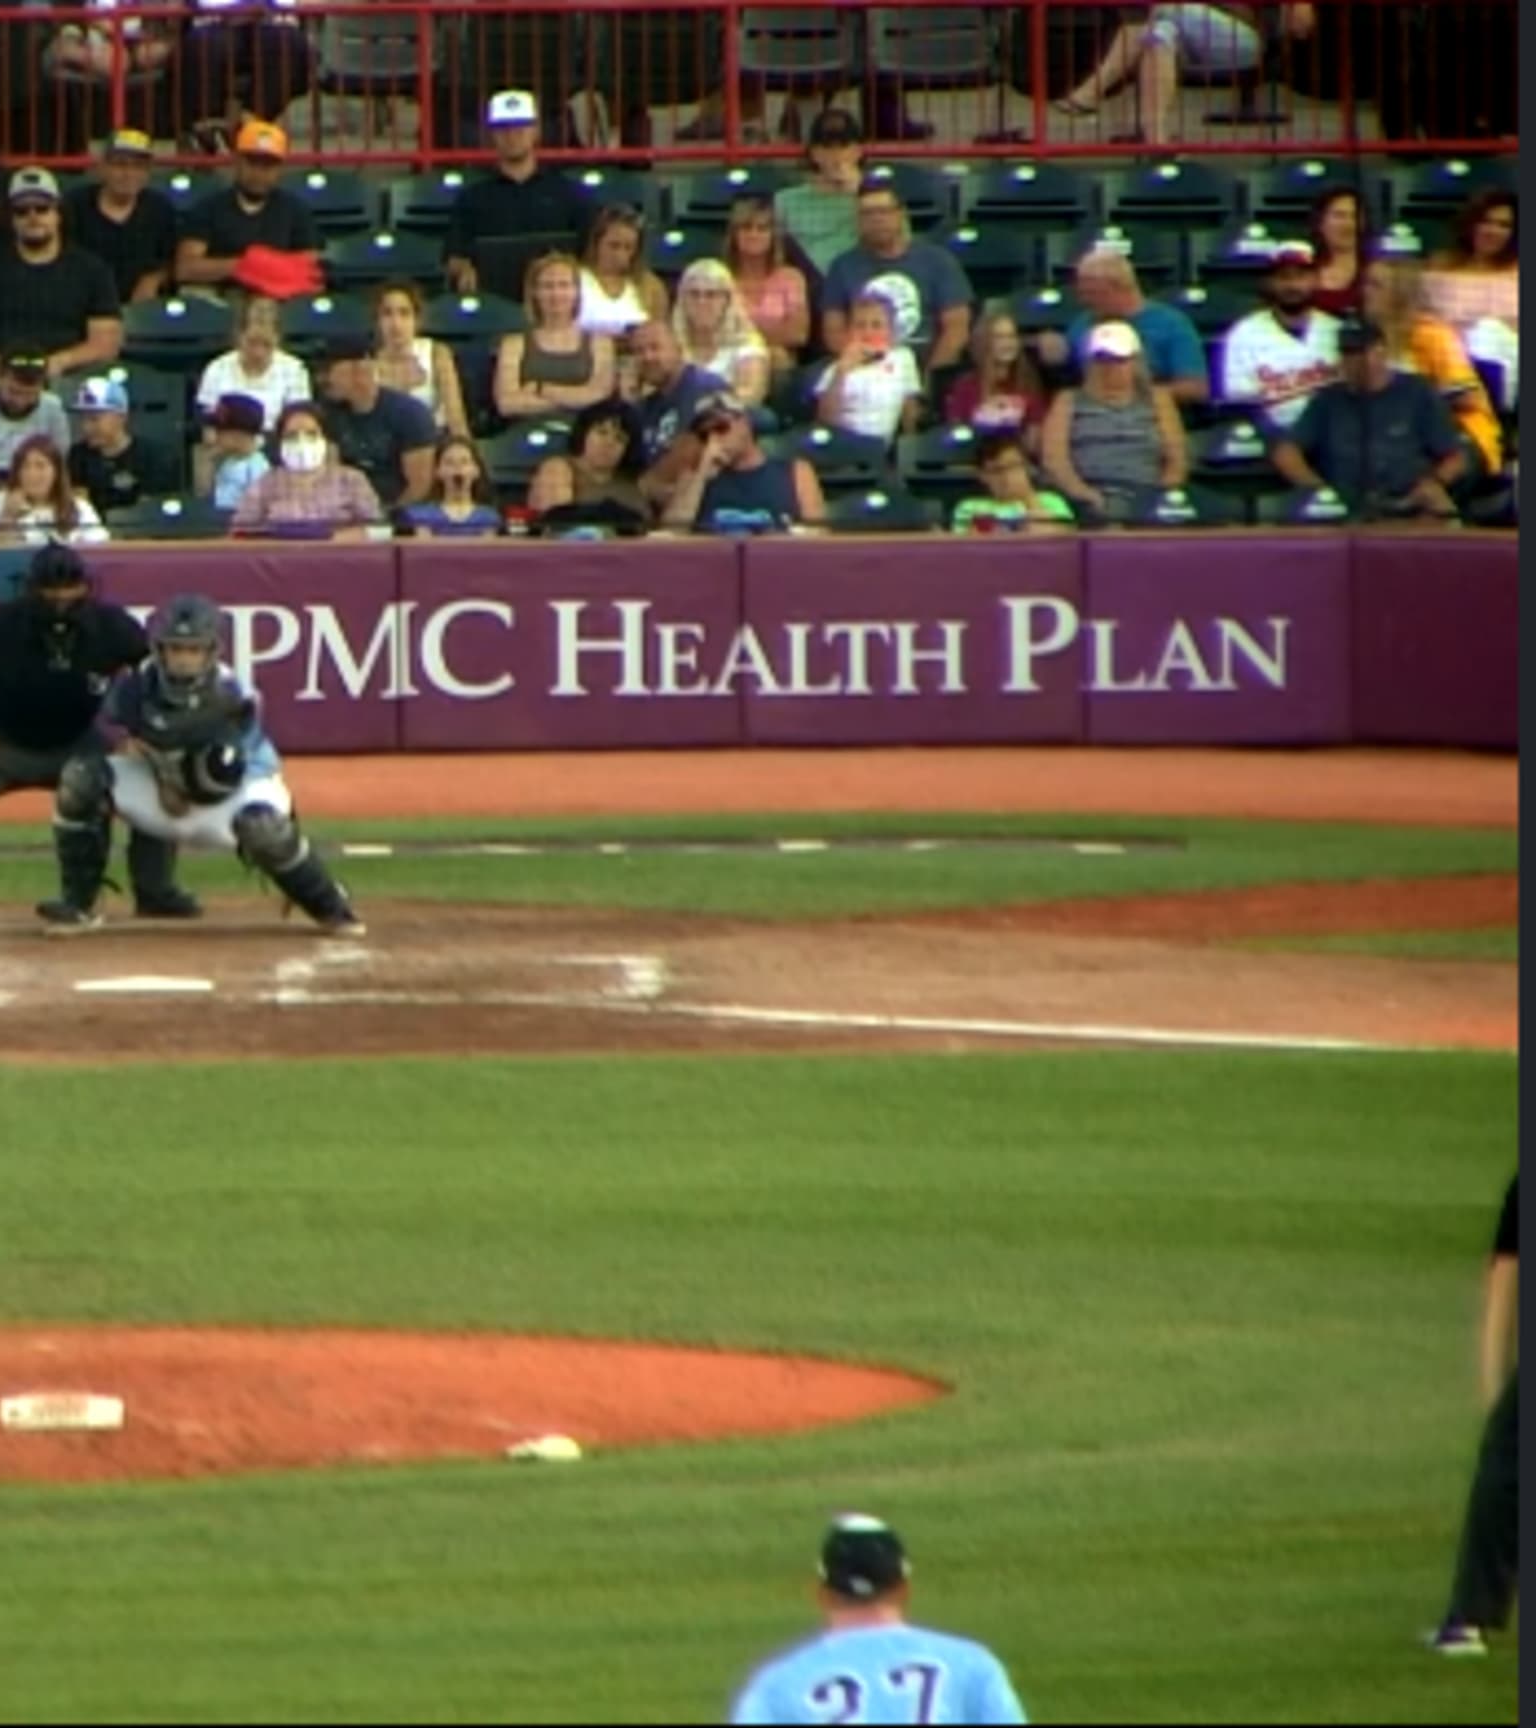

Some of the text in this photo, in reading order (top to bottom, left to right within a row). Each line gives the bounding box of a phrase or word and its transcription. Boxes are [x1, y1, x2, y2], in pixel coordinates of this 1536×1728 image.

[125, 596, 1293, 702] PMC HEALTH PLAN
[812, 1662, 941, 1724] 27
